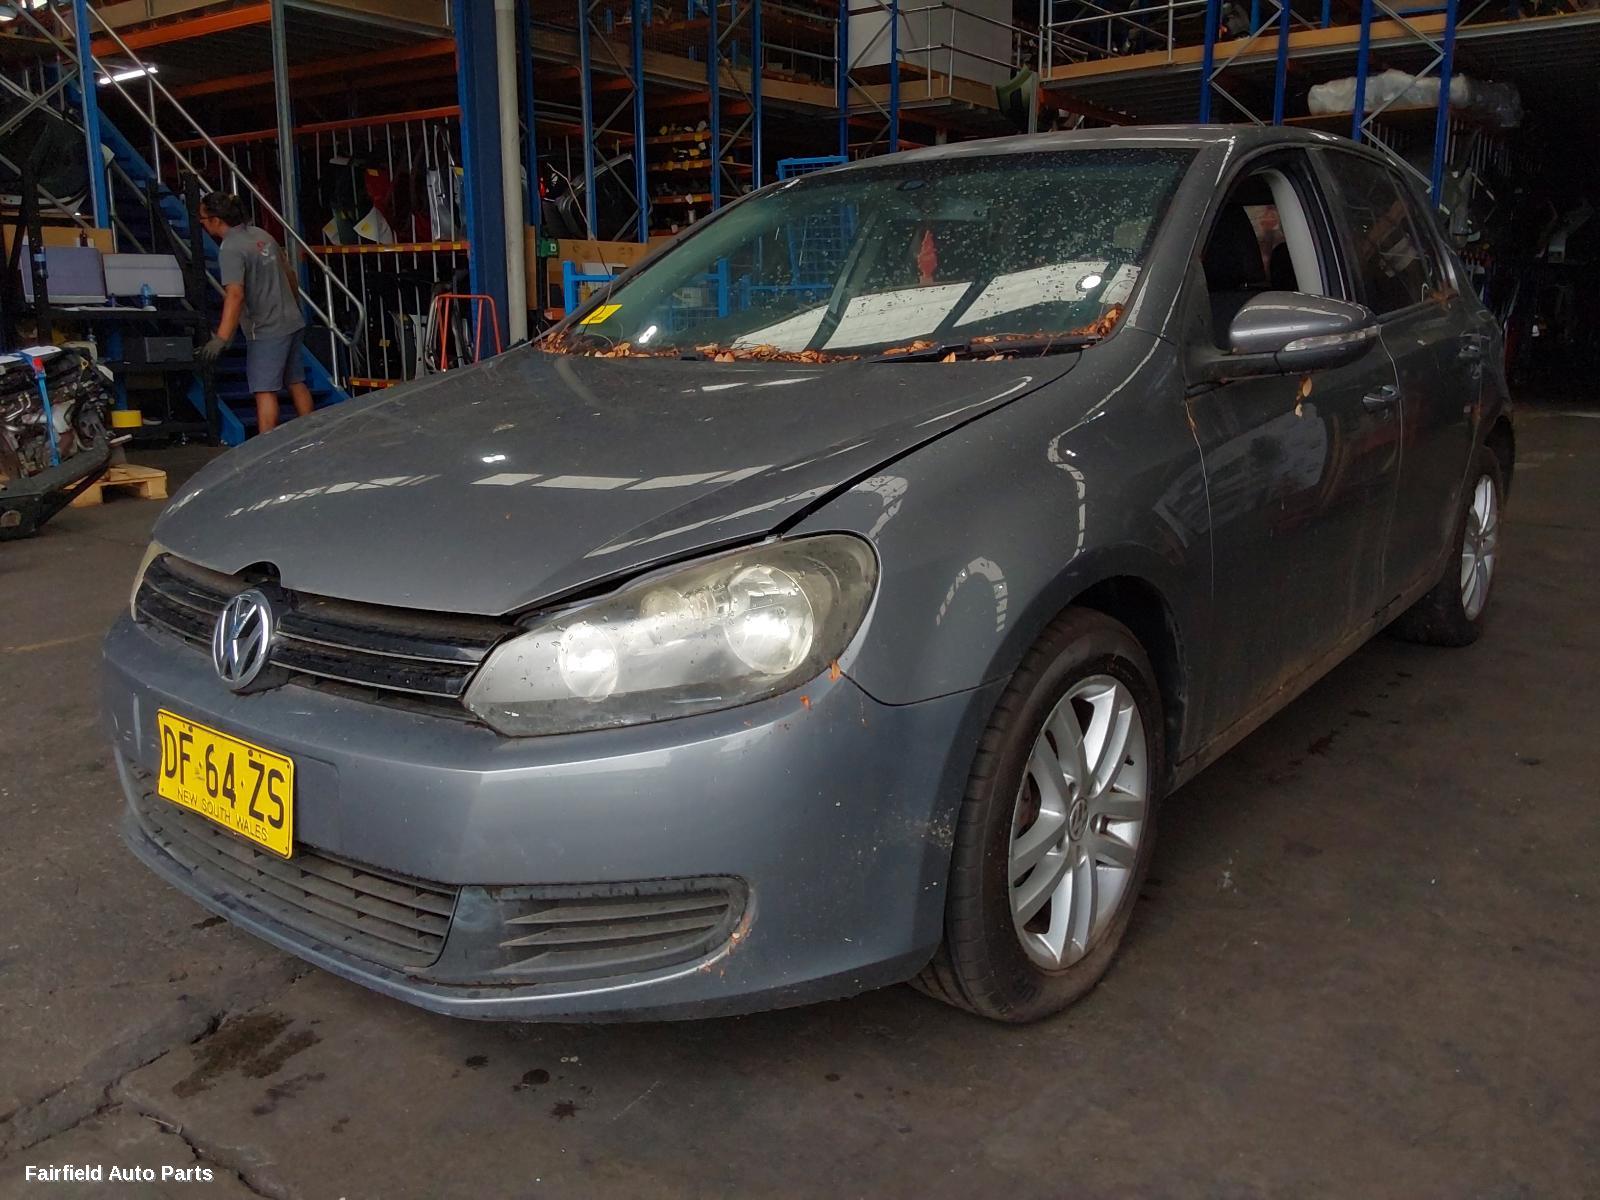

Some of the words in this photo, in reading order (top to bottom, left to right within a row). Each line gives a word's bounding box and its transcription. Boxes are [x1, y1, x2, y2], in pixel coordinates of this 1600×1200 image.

[163, 724, 194, 785] DF
[205, 743, 236, 809] 64
[248, 758, 285, 829] ZS
[177, 786, 198, 805] NEW
[202, 798, 231, 823] SOUTH
[236, 813, 268, 841] WALES
